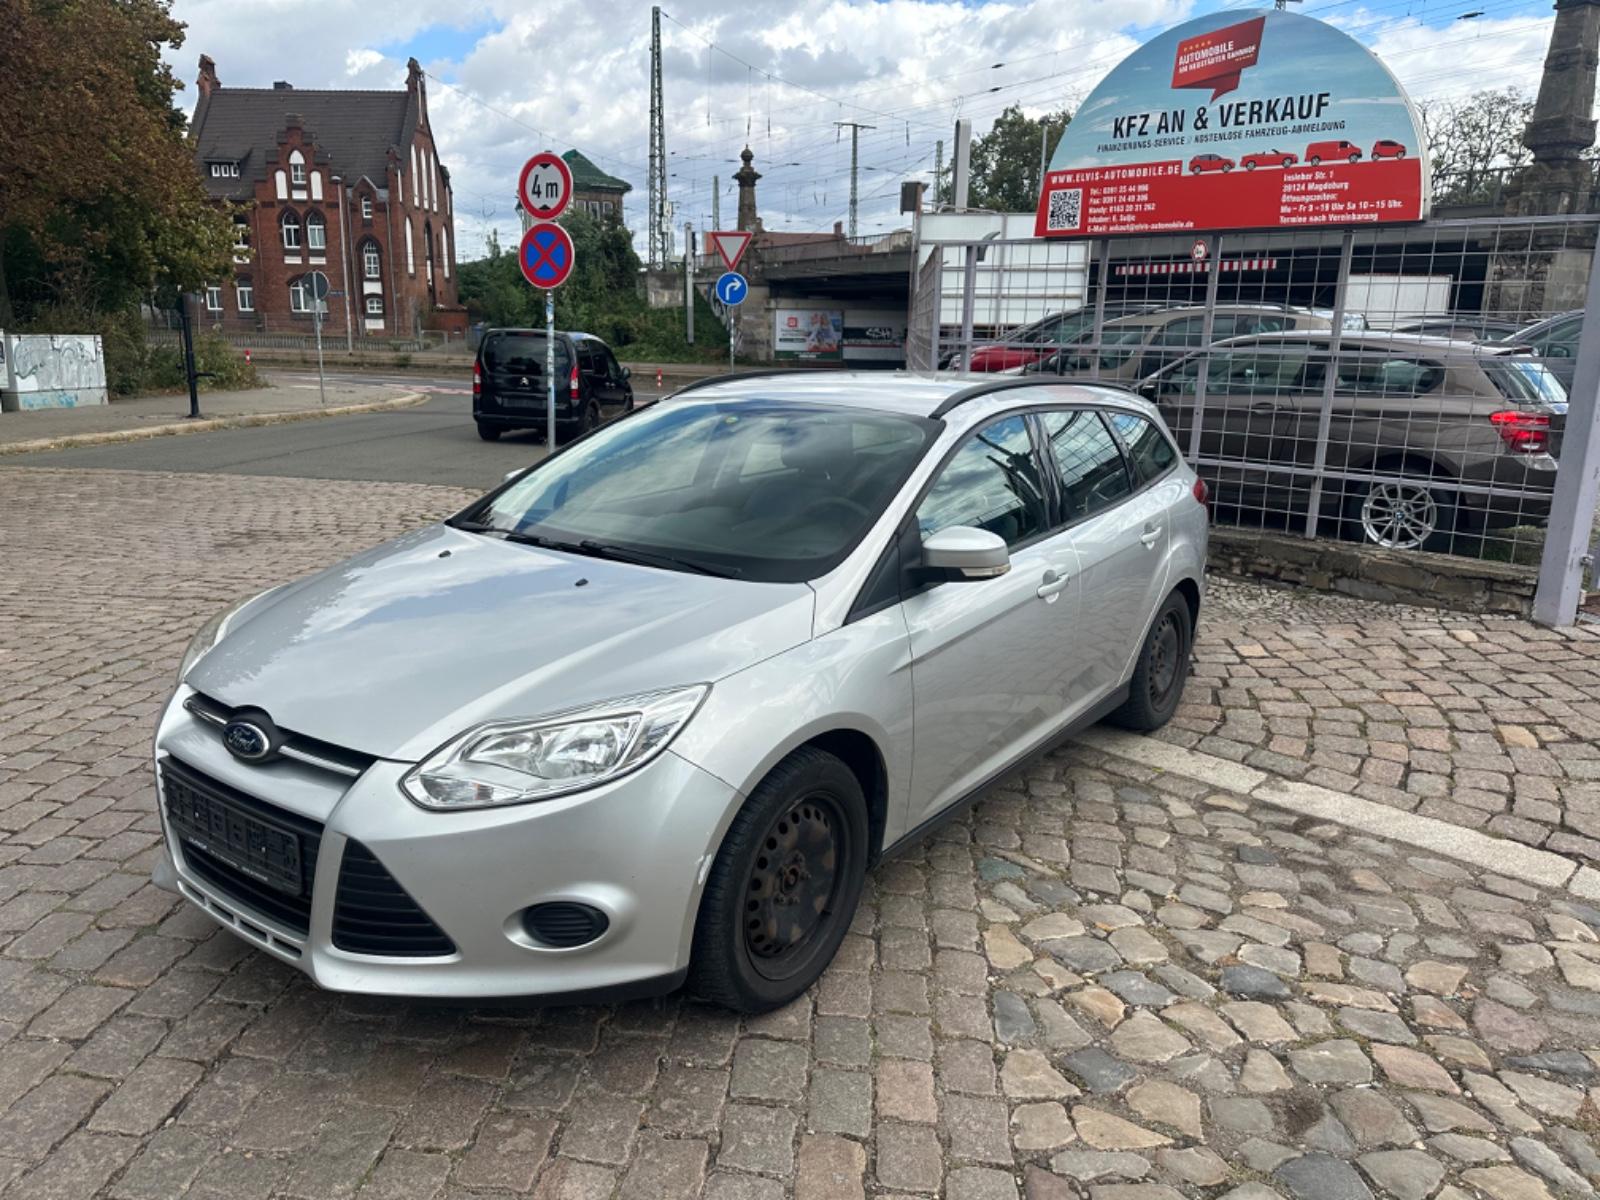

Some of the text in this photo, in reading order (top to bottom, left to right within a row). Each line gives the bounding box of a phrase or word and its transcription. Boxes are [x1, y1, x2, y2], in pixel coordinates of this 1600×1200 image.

[1179, 41, 1234, 65] AUTOMOBILE
[1112, 92, 1331, 139] KFZ AN & VERKAUF
[1195, 131, 1242, 144] KOSTENLOSE
[1245, 120, 1345, 138] FAHRZEUG-ABMELDUNG
[532, 174, 558, 198] 4 m
[1051, 165, 1180, 184] WWW.ELVIS-AUTOMOBILE.DE
[1307, 181, 1349, 191] Magdeburg
[1359, 201, 1368, 209] 10
